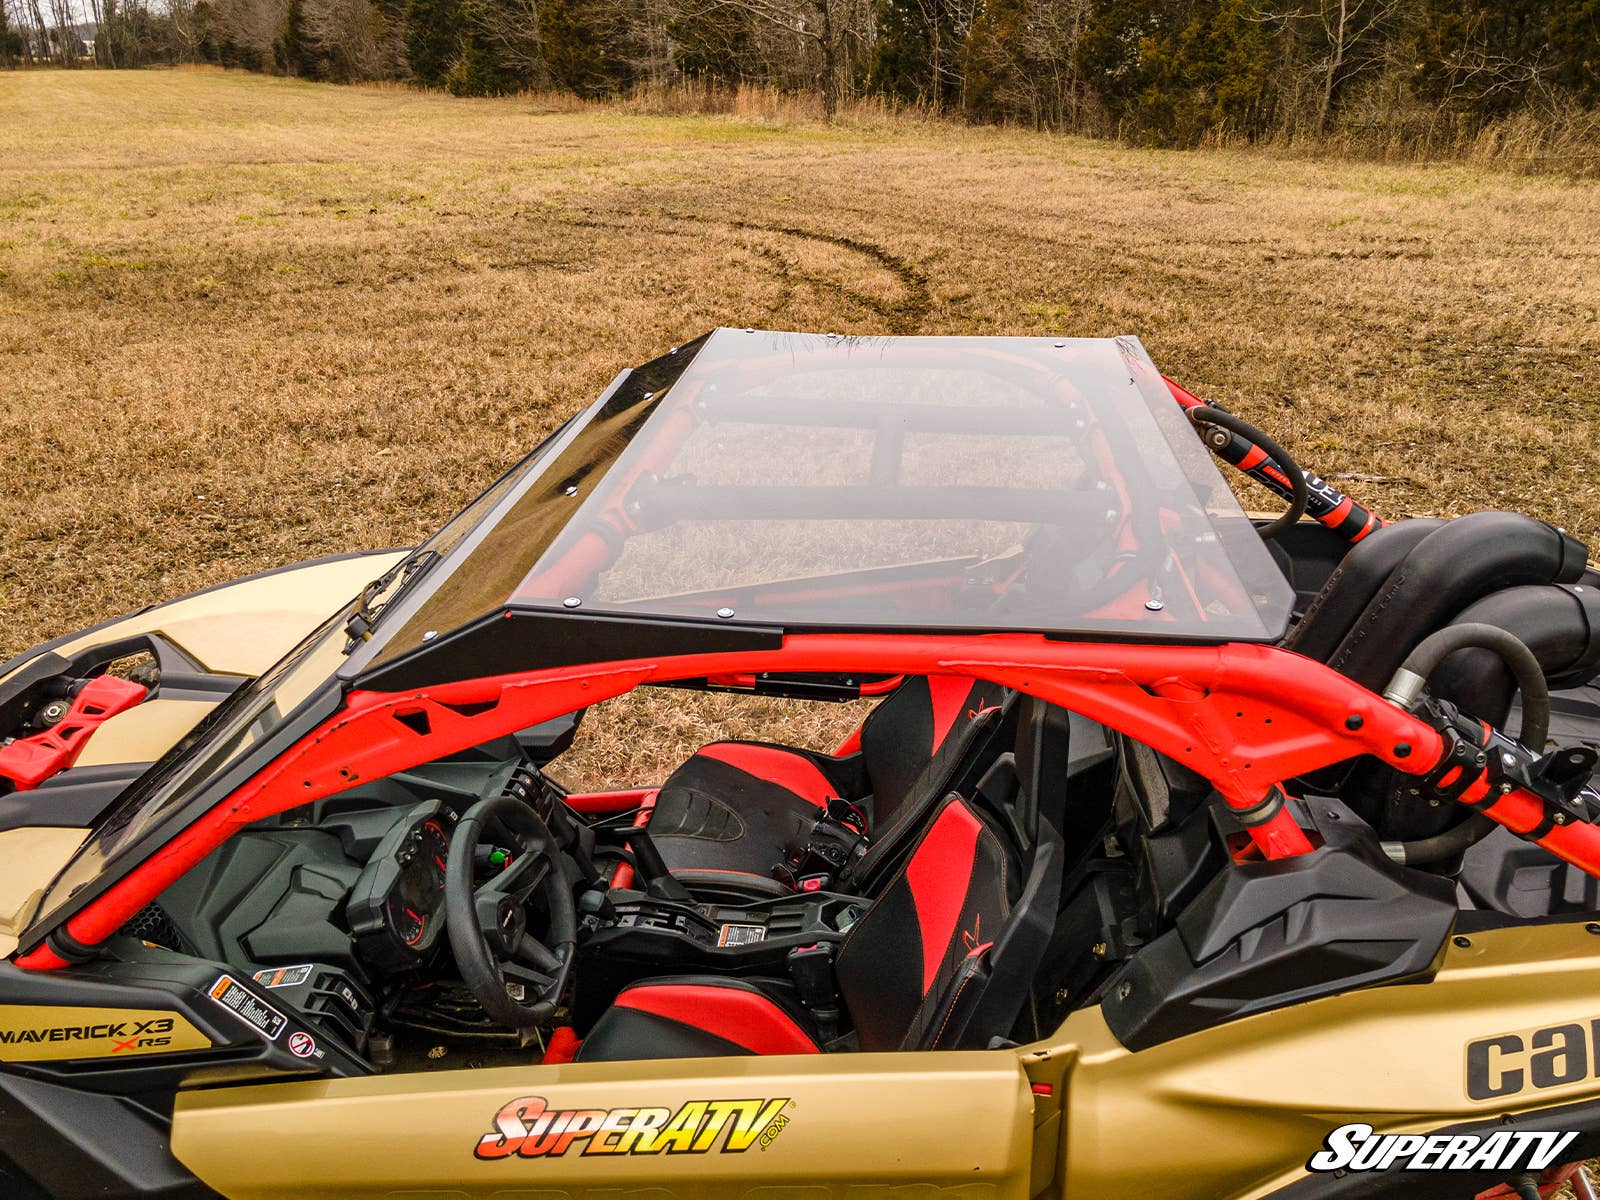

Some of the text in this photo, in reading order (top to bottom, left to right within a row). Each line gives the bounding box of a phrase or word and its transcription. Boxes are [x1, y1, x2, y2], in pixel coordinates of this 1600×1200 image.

[0, 1017, 175, 1044] MAVERICK X3
[1466, 1018, 1600, 1101] ca
